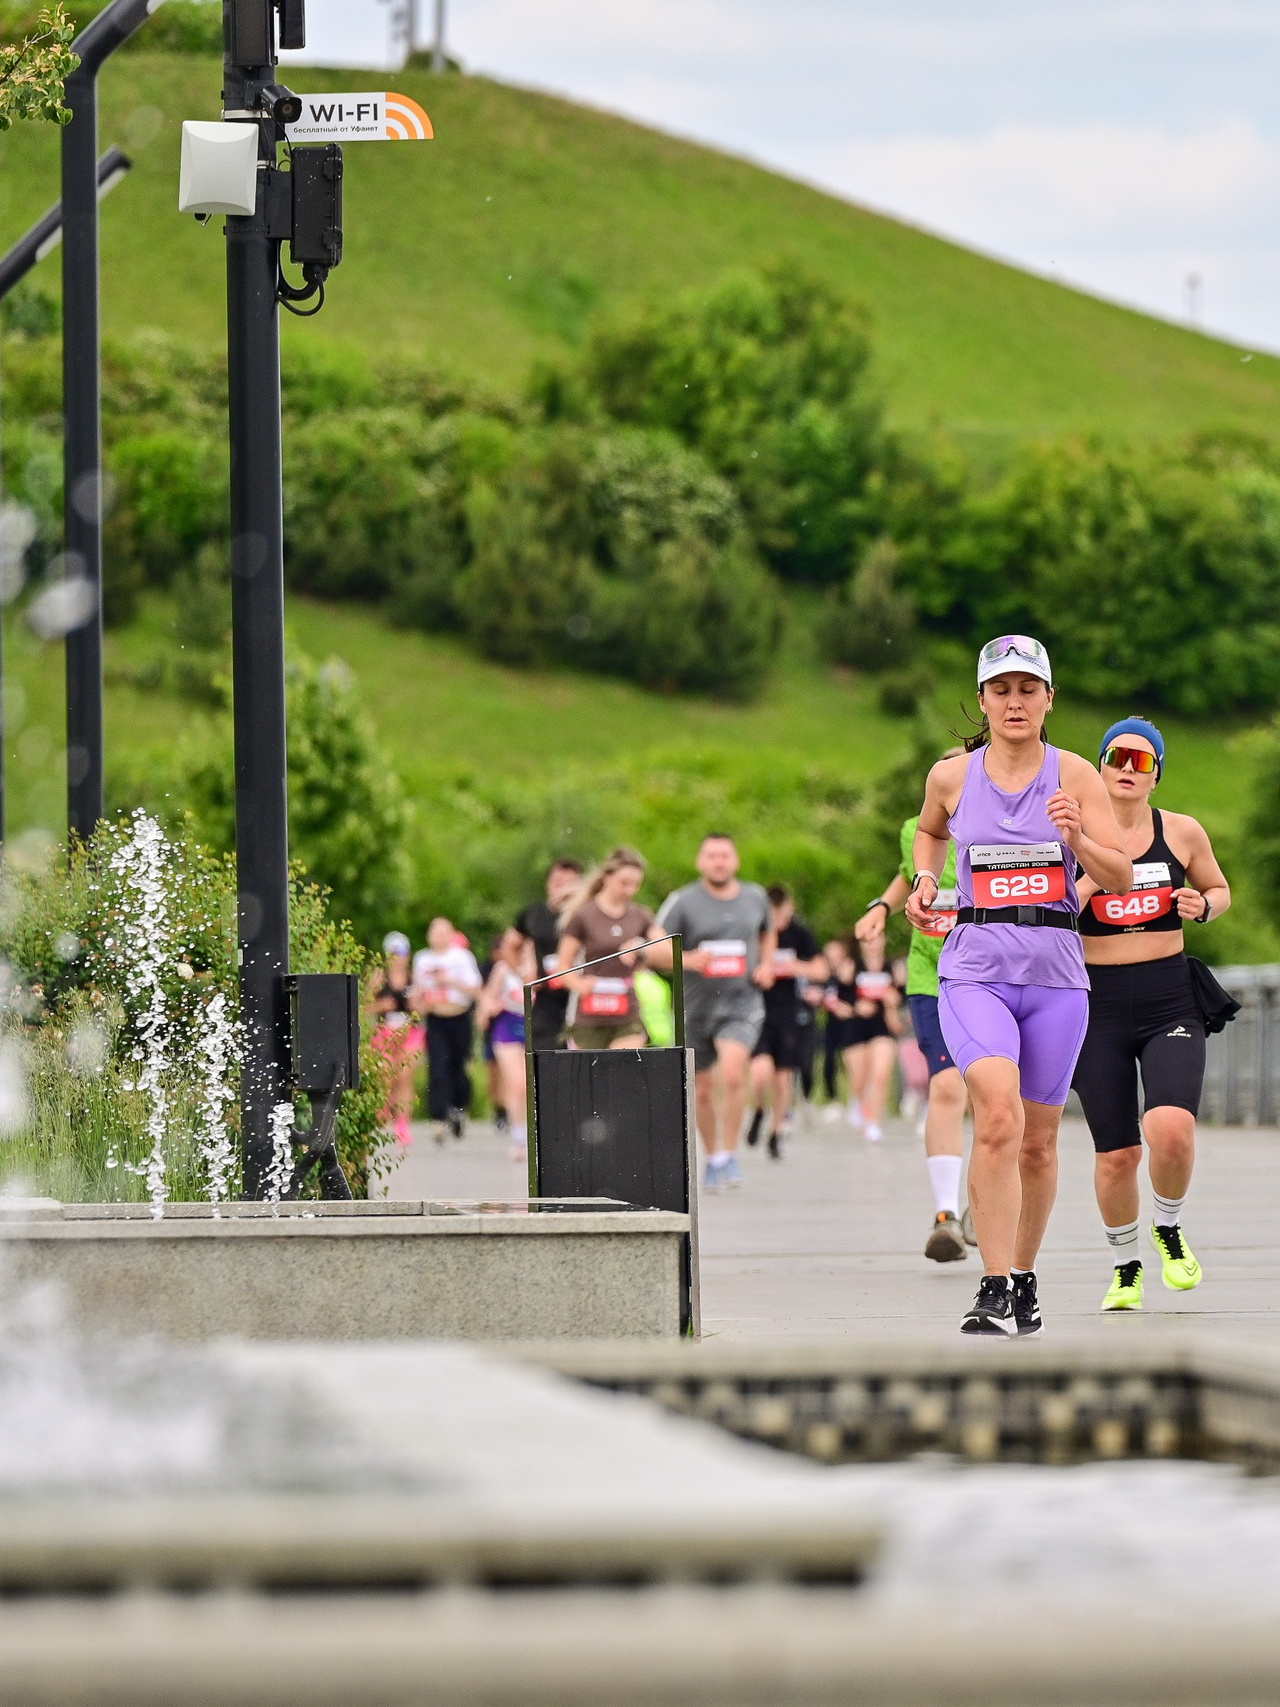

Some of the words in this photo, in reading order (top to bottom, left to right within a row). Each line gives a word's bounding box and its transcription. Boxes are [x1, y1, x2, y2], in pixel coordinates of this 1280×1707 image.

[309, 103, 378, 122] WI-FI
[293, 126, 338, 134] бесплатный
[987, 862, 1030, 870] ТАТАРСТАН
[990, 873, 1049, 898] 629
[1105, 895, 1160, 919] 648
